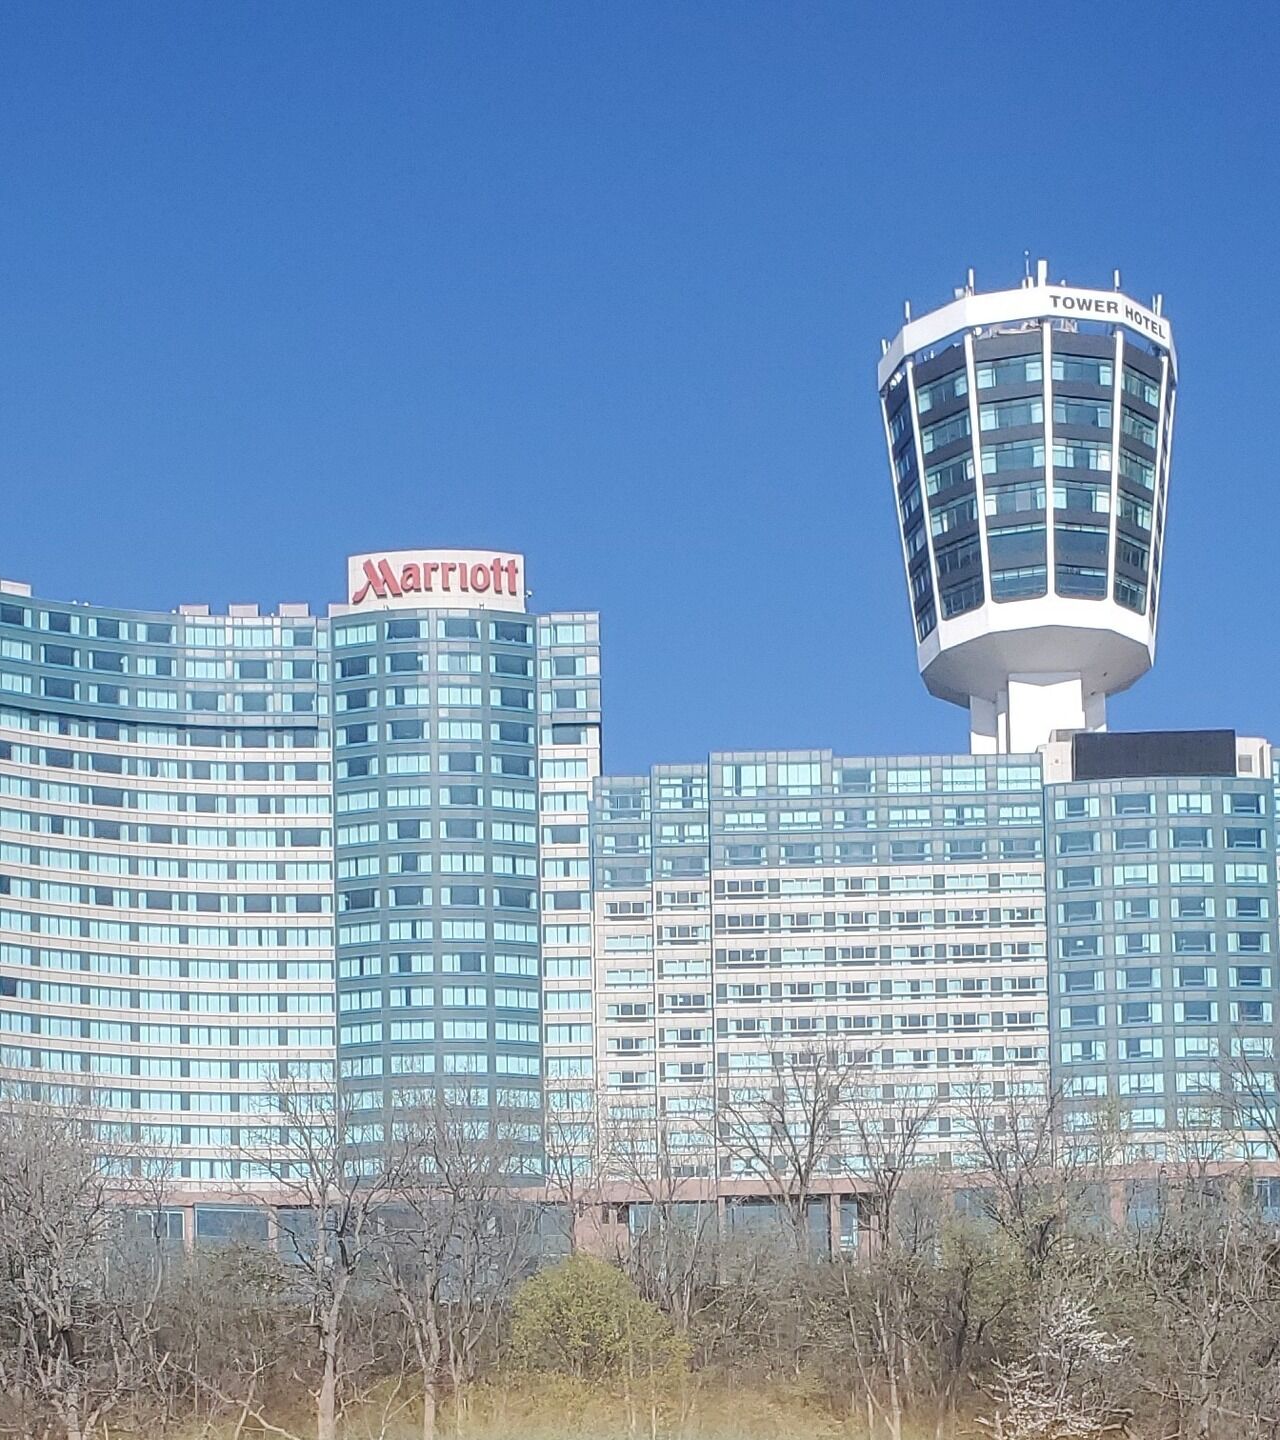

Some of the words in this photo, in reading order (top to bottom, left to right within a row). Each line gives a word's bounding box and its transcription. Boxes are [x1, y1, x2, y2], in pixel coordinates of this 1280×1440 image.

[1049, 294, 1119, 314] TOWER
[1125, 304, 1166, 340] HOTEL
[352, 557, 519, 605] Marriott
